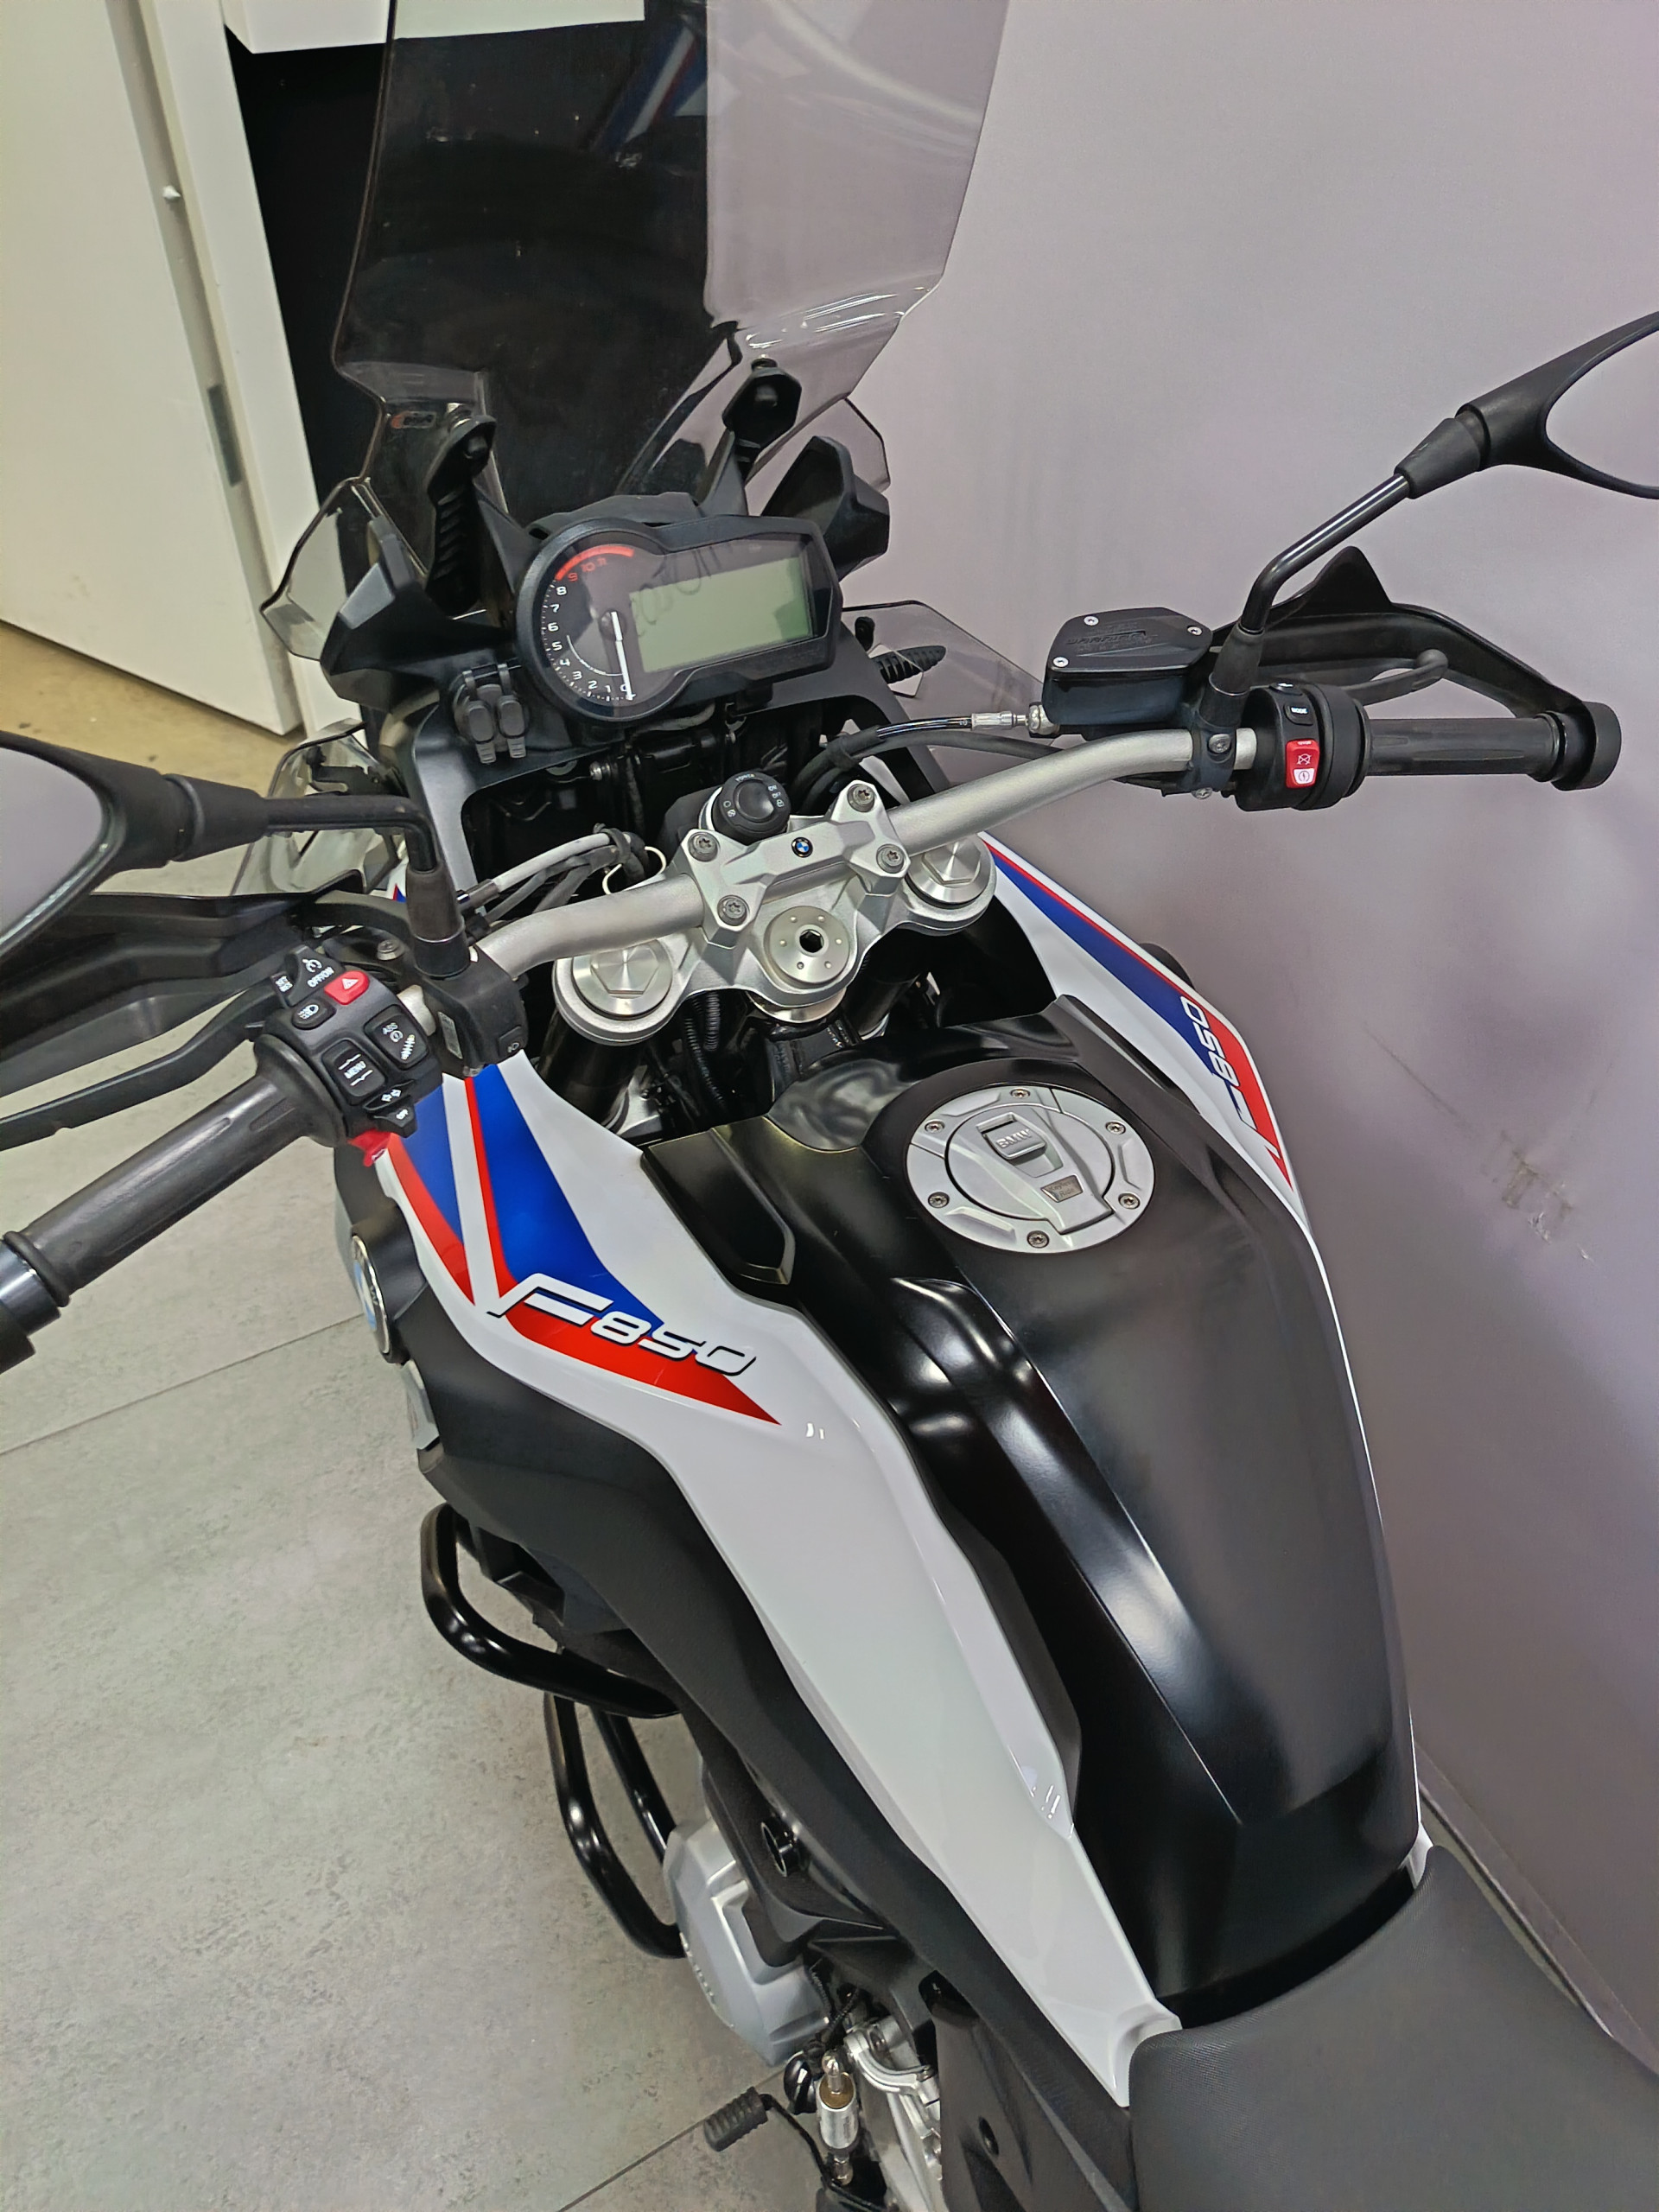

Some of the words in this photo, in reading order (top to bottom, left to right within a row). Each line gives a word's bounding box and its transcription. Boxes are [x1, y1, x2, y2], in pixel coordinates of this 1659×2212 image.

[581, 563, 596, 573] 10
[568, 572, 578, 582] 9
[556, 586, 568, 596] 8
[550, 603, 560, 613] 7
[547, 622, 559, 632] 6
[551, 641, 563, 652] 5
[560, 658, 571, 667] 4
[572, 671, 582, 680] 3
[588, 680, 598, 690] 2
[605, 684, 612, 693] 1
[344, 1060, 367, 1079] MENU
[996, 1128, 1033, 1148] BMW
[486, 1272, 757, 1376] F850
